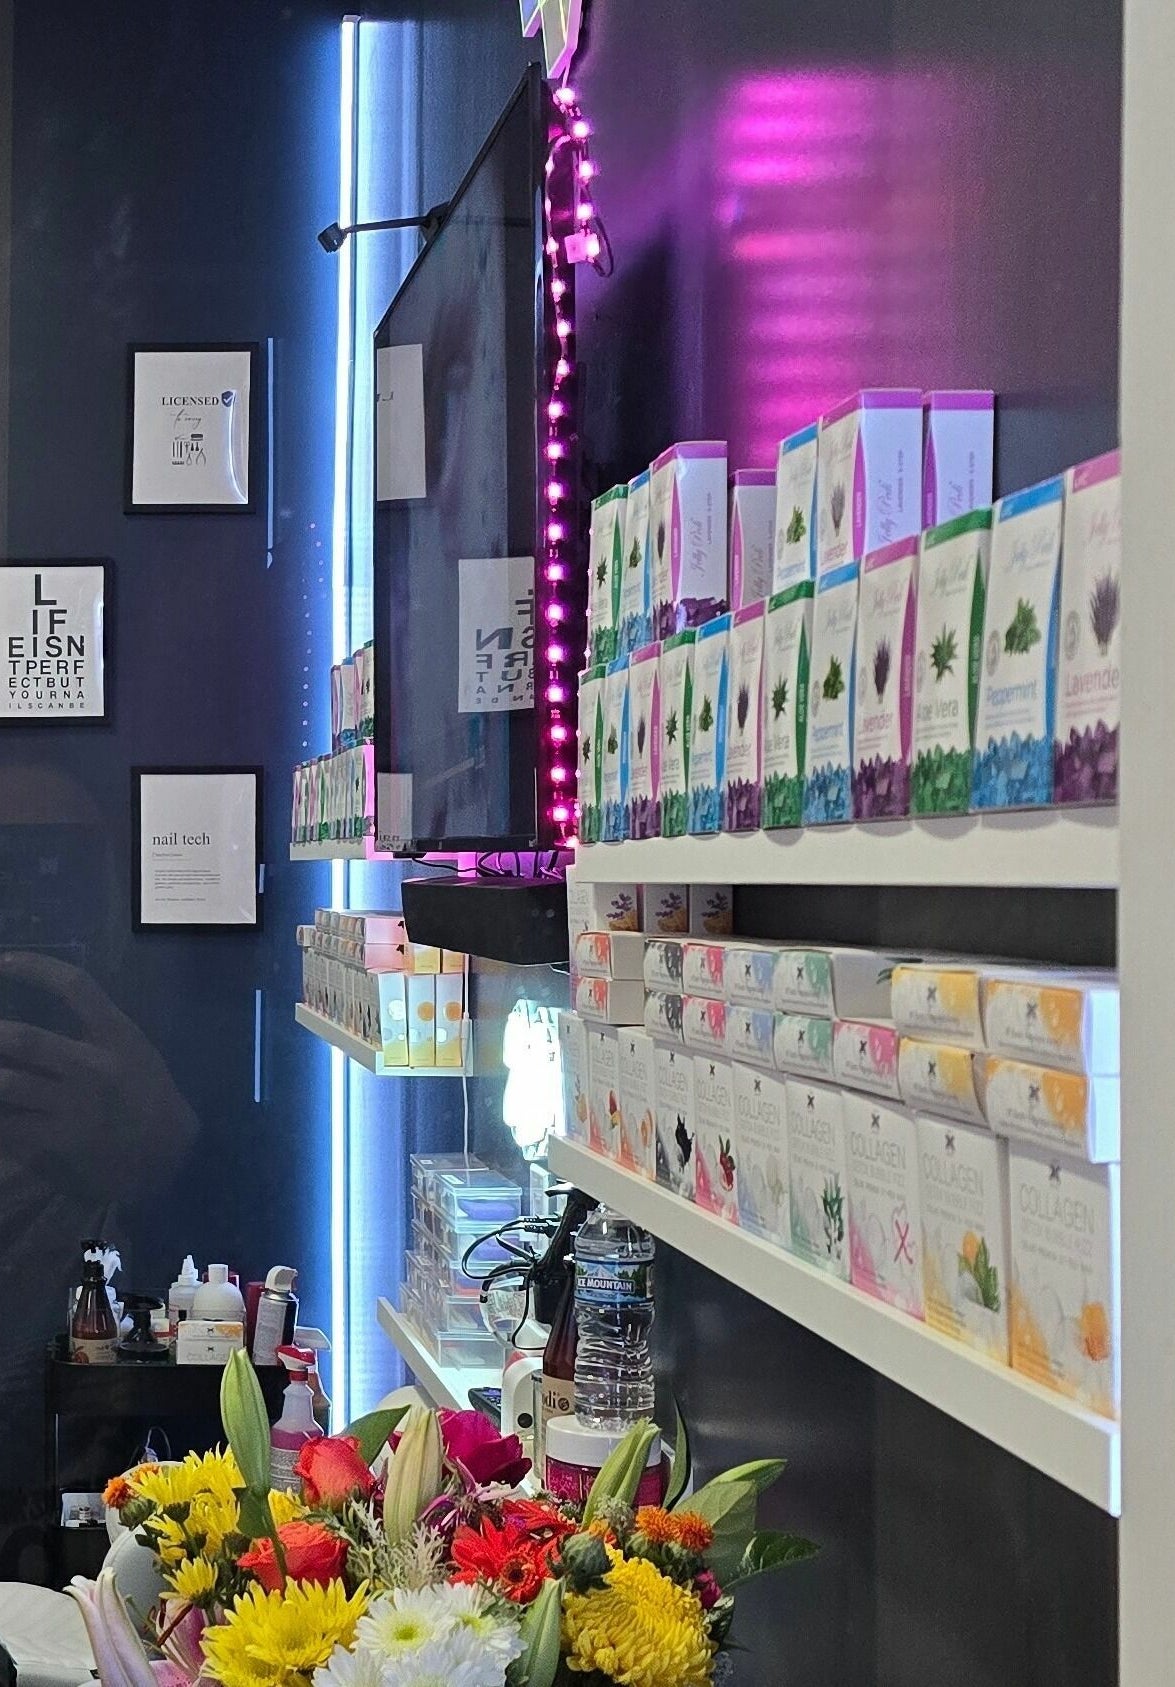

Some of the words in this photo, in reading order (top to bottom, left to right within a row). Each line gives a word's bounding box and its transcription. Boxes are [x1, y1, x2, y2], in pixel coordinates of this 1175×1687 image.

[162, 396, 219, 406] LICENSED
[34, 574, 57, 606] L
[8, 659, 85, 675] TPERF
[1065, 664, 1120, 697] Lavende
[152, 832, 178, 846] nail
[182, 832, 211, 846] tech
[587, 1278, 632, 1292] MOUNTAIN
